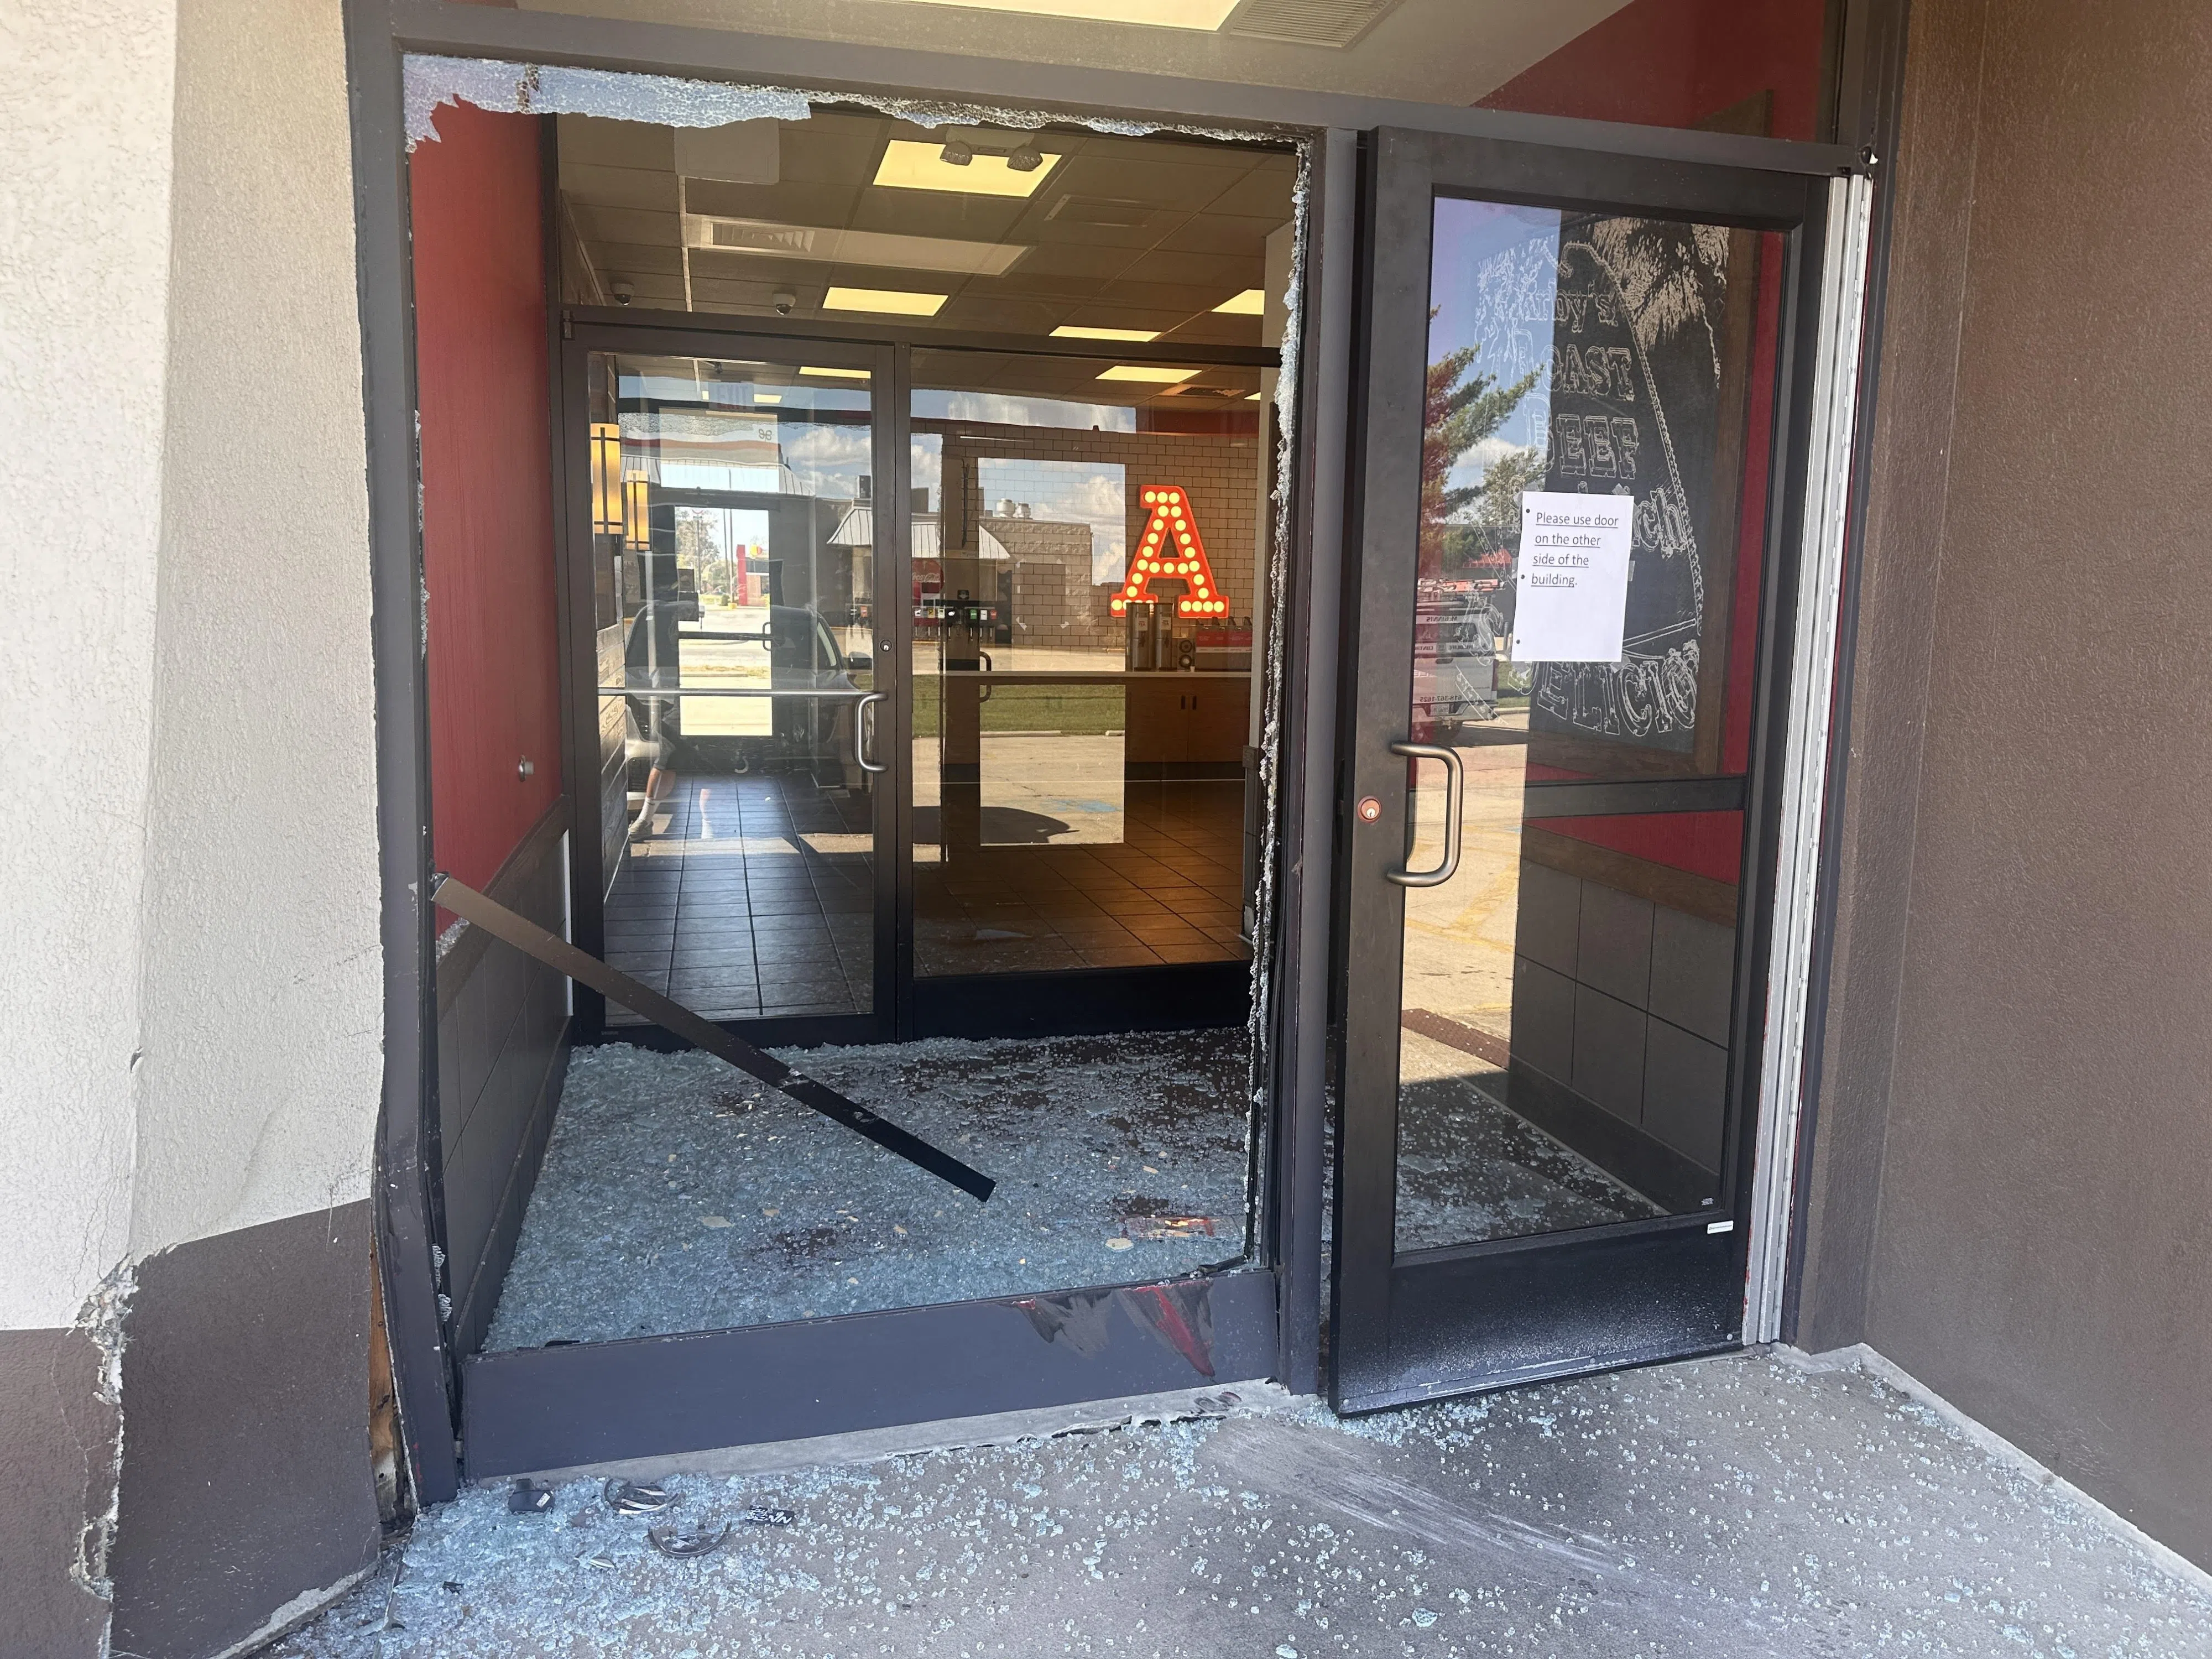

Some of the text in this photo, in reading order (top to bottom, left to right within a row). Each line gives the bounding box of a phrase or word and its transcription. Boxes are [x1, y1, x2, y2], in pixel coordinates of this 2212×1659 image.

[717, 384, 748, 410] EXIT
[1522, 392, 1639, 480] BEEF
[1536, 512, 1619, 526] Please use door
[1535, 533, 1601, 545] on the other
[1110, 485, 1229, 618] A
[1533, 553, 1589, 565] side of the
[1532, 572, 1577, 587] building.
